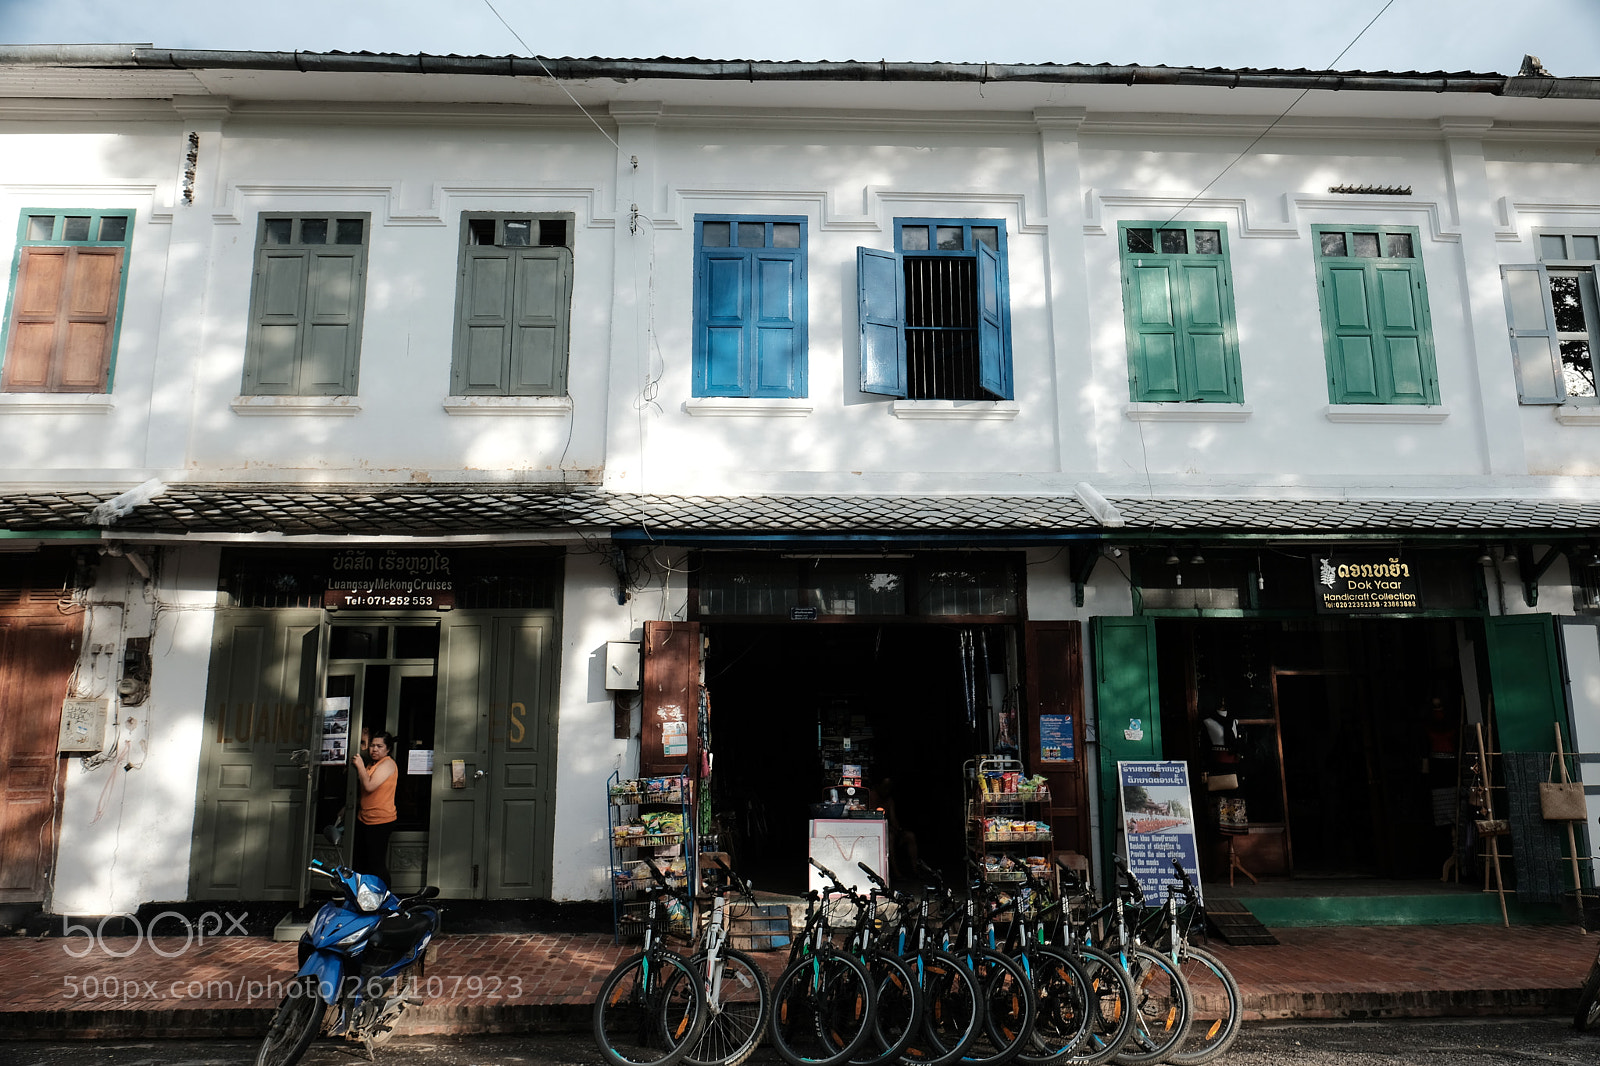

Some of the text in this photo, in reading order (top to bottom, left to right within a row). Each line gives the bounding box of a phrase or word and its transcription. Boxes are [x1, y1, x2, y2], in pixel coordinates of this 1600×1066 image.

[1348, 580, 1402, 590] Dok Yaar
[1323, 592, 1416, 601] Handicraft Collection
